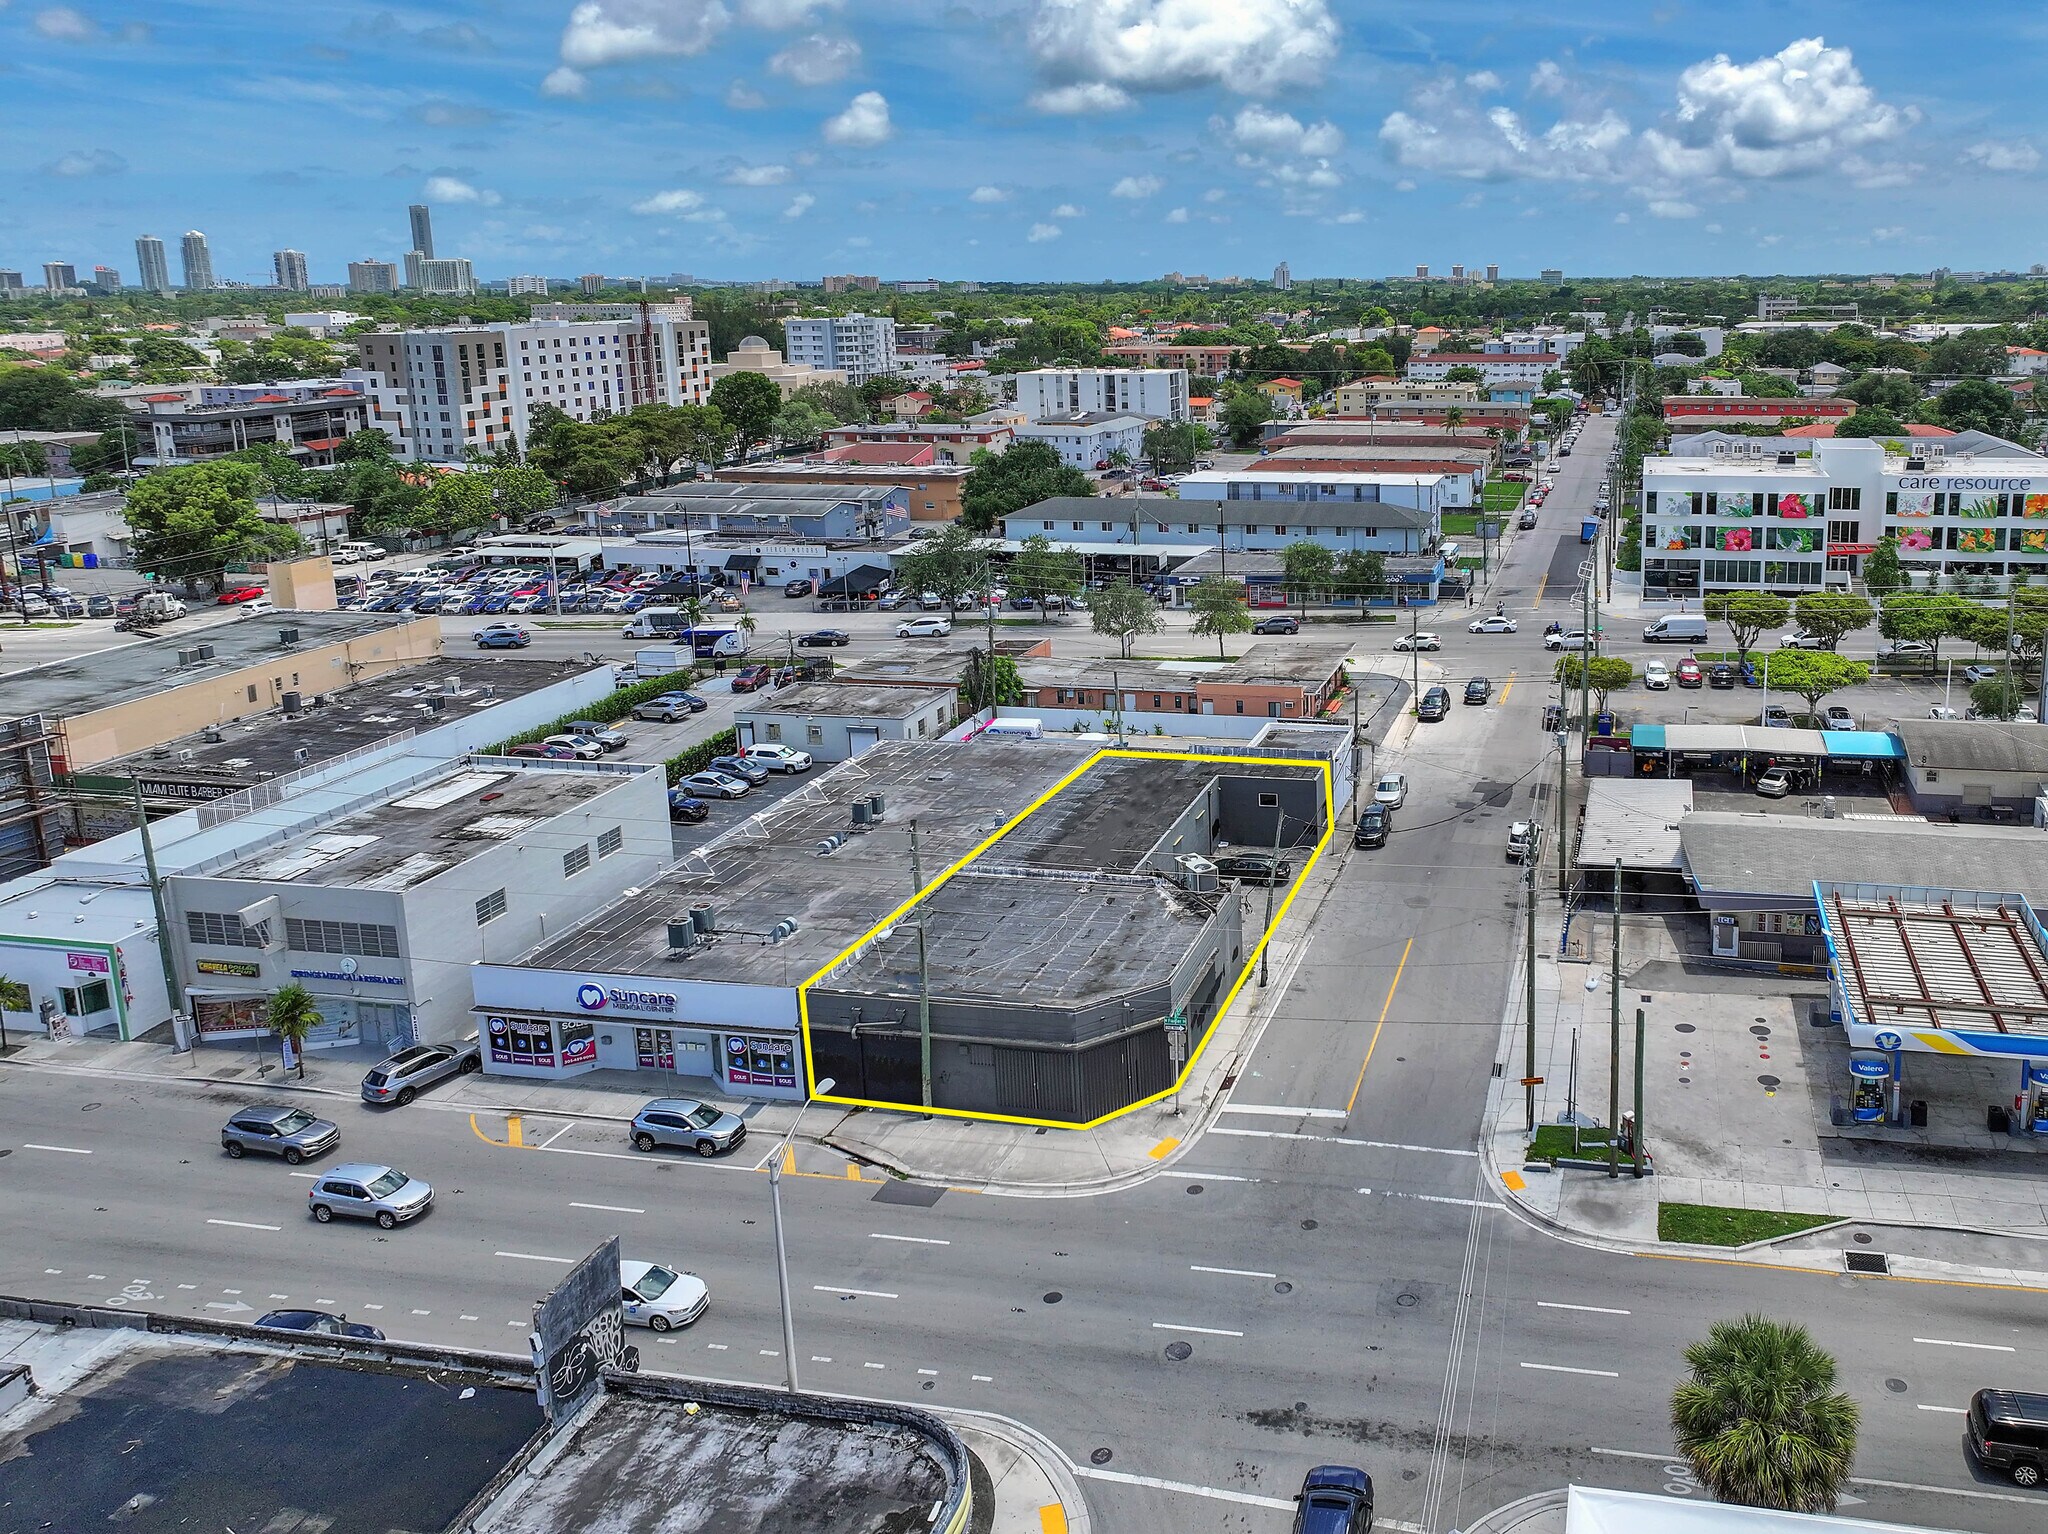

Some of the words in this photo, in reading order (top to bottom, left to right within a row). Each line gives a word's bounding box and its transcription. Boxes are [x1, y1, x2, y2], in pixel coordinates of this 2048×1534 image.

[1898, 477, 1940, 490] care
[1946, 478, 2031, 491] resource
[141, 783, 168, 796] MIAMI
[168, 784, 189, 797] ELITE
[191, 785, 223, 798] BARBER
[612, 1002, 647, 1012] MEDICAL
[647, 1005, 676, 1014] CENTER
[1858, 1064, 1884, 1072] Valero
